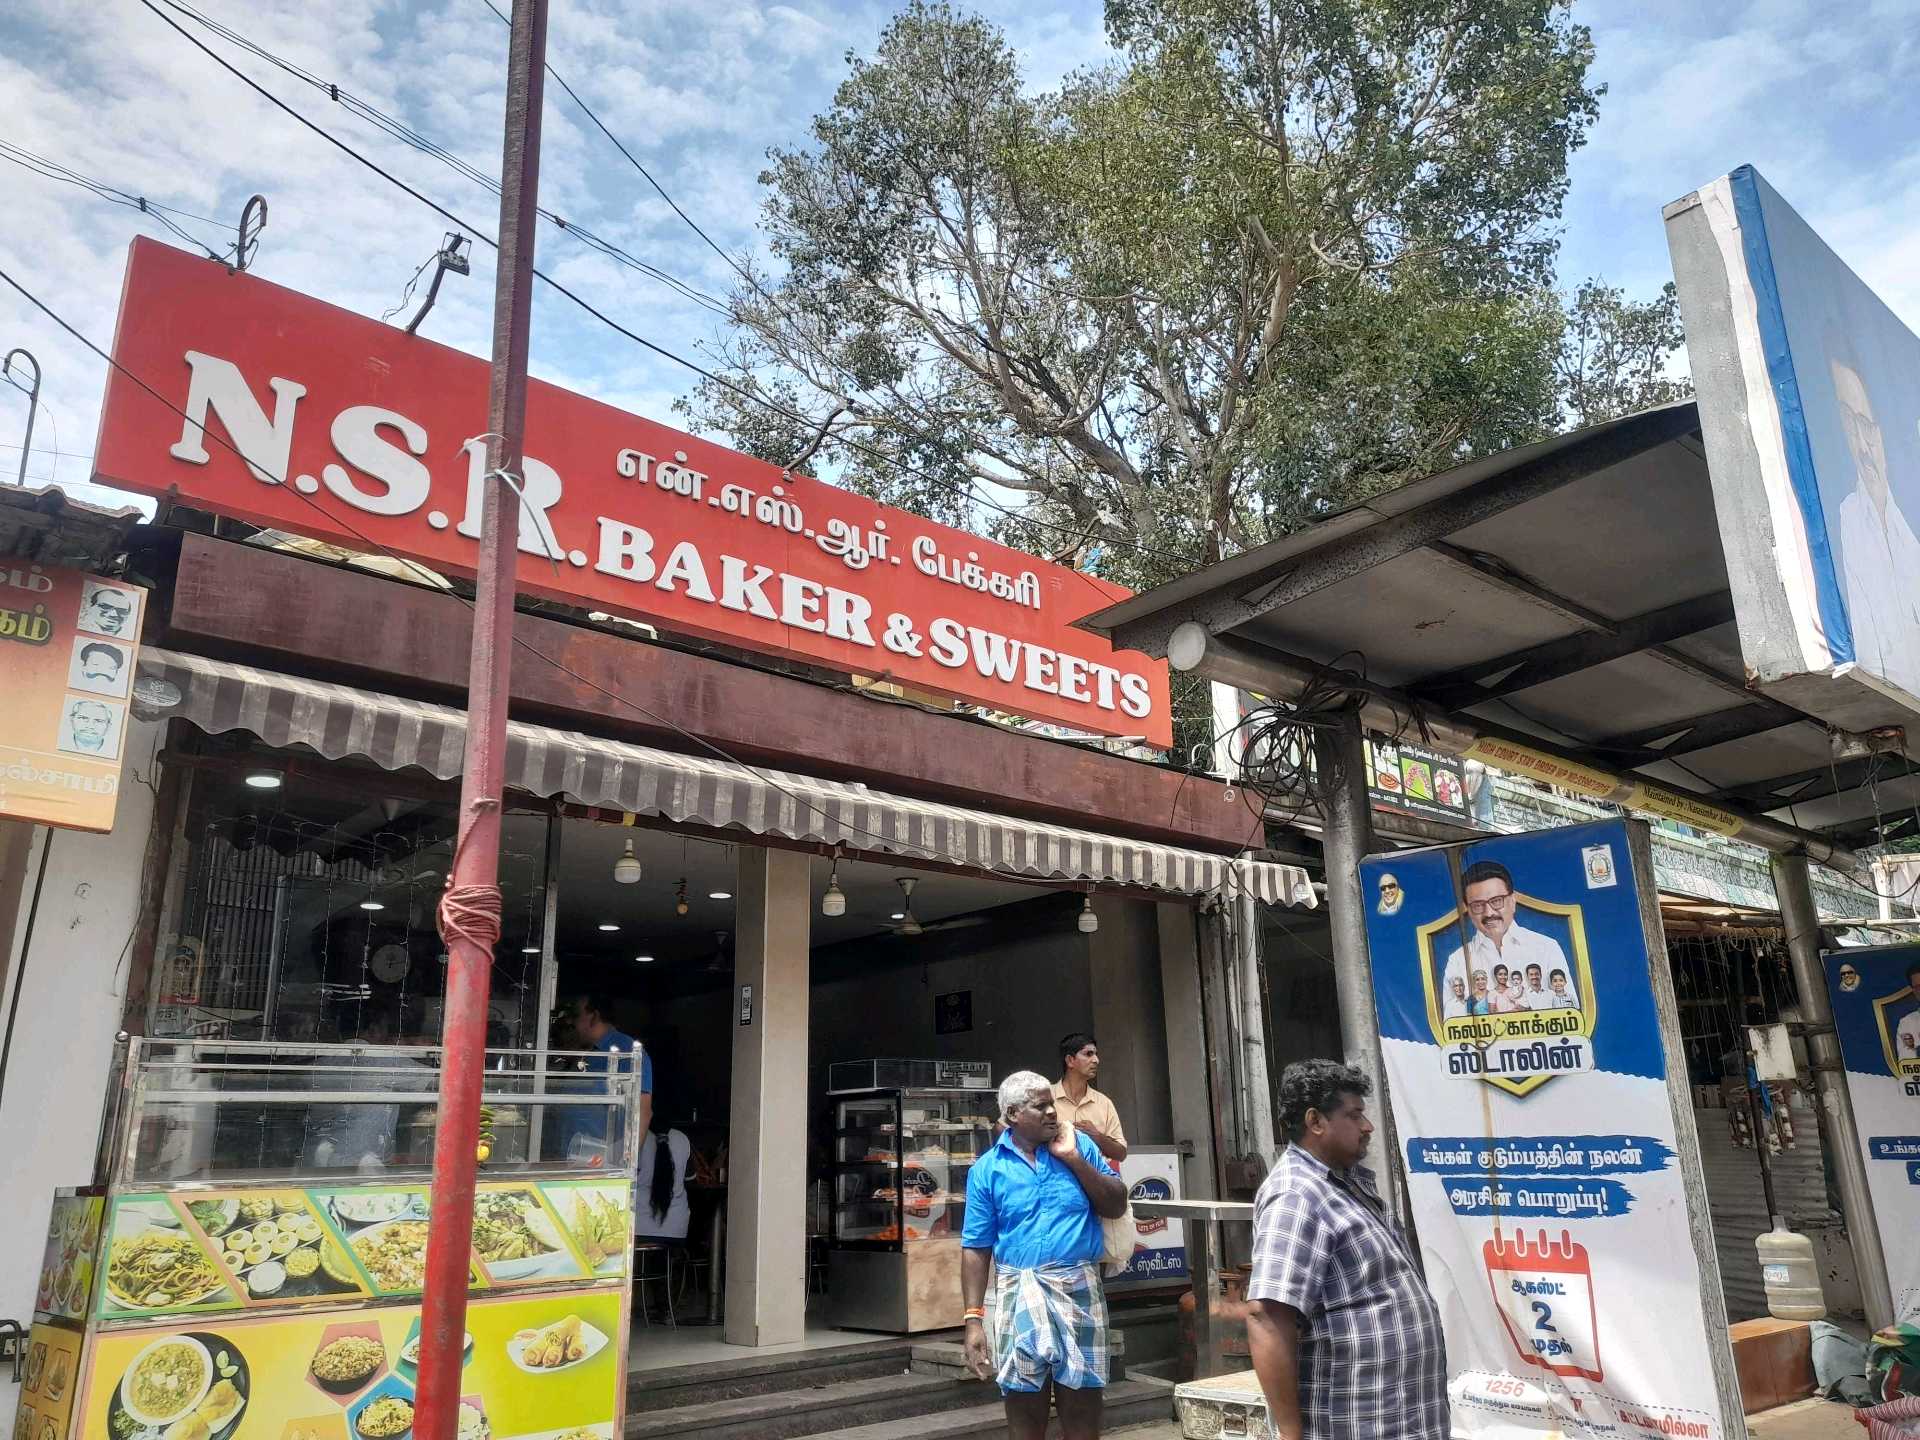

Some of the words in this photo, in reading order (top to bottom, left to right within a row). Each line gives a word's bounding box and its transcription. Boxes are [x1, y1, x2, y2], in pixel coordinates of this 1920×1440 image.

[616, 447, 902, 569] என்.எஸ்.ஆர்.
[911, 534, 1042, 610] பேக்கரி
[595, 516, 876, 648] BAKER
[882, 612, 924, 658] &
[929, 617, 1152, 719] SWEETS
[1447, 1018, 1492, 1041] நலம்
[1506, 1011, 1579, 1036] காக்கும்
[1448, 1038, 1583, 1075] ஸ்டாலின்
[1423, 1142, 1472, 1166] உங்கள்
[1478, 1142, 1583, 1170] குடும்பத்தின்
[1588, 1138, 1643, 1170] நலன்
[1132, 1183, 1164, 1200] Dairy
[1450, 1184, 1512, 1210] அரசின்
[1517, 1184, 1608, 1215] பொறுப்பு!
[1511, 1276, 1567, 1297] ஆகஸ்ட்
[1531, 1300, 1557, 1332] 2
[1485, 1378, 1525, 1398] 1256
